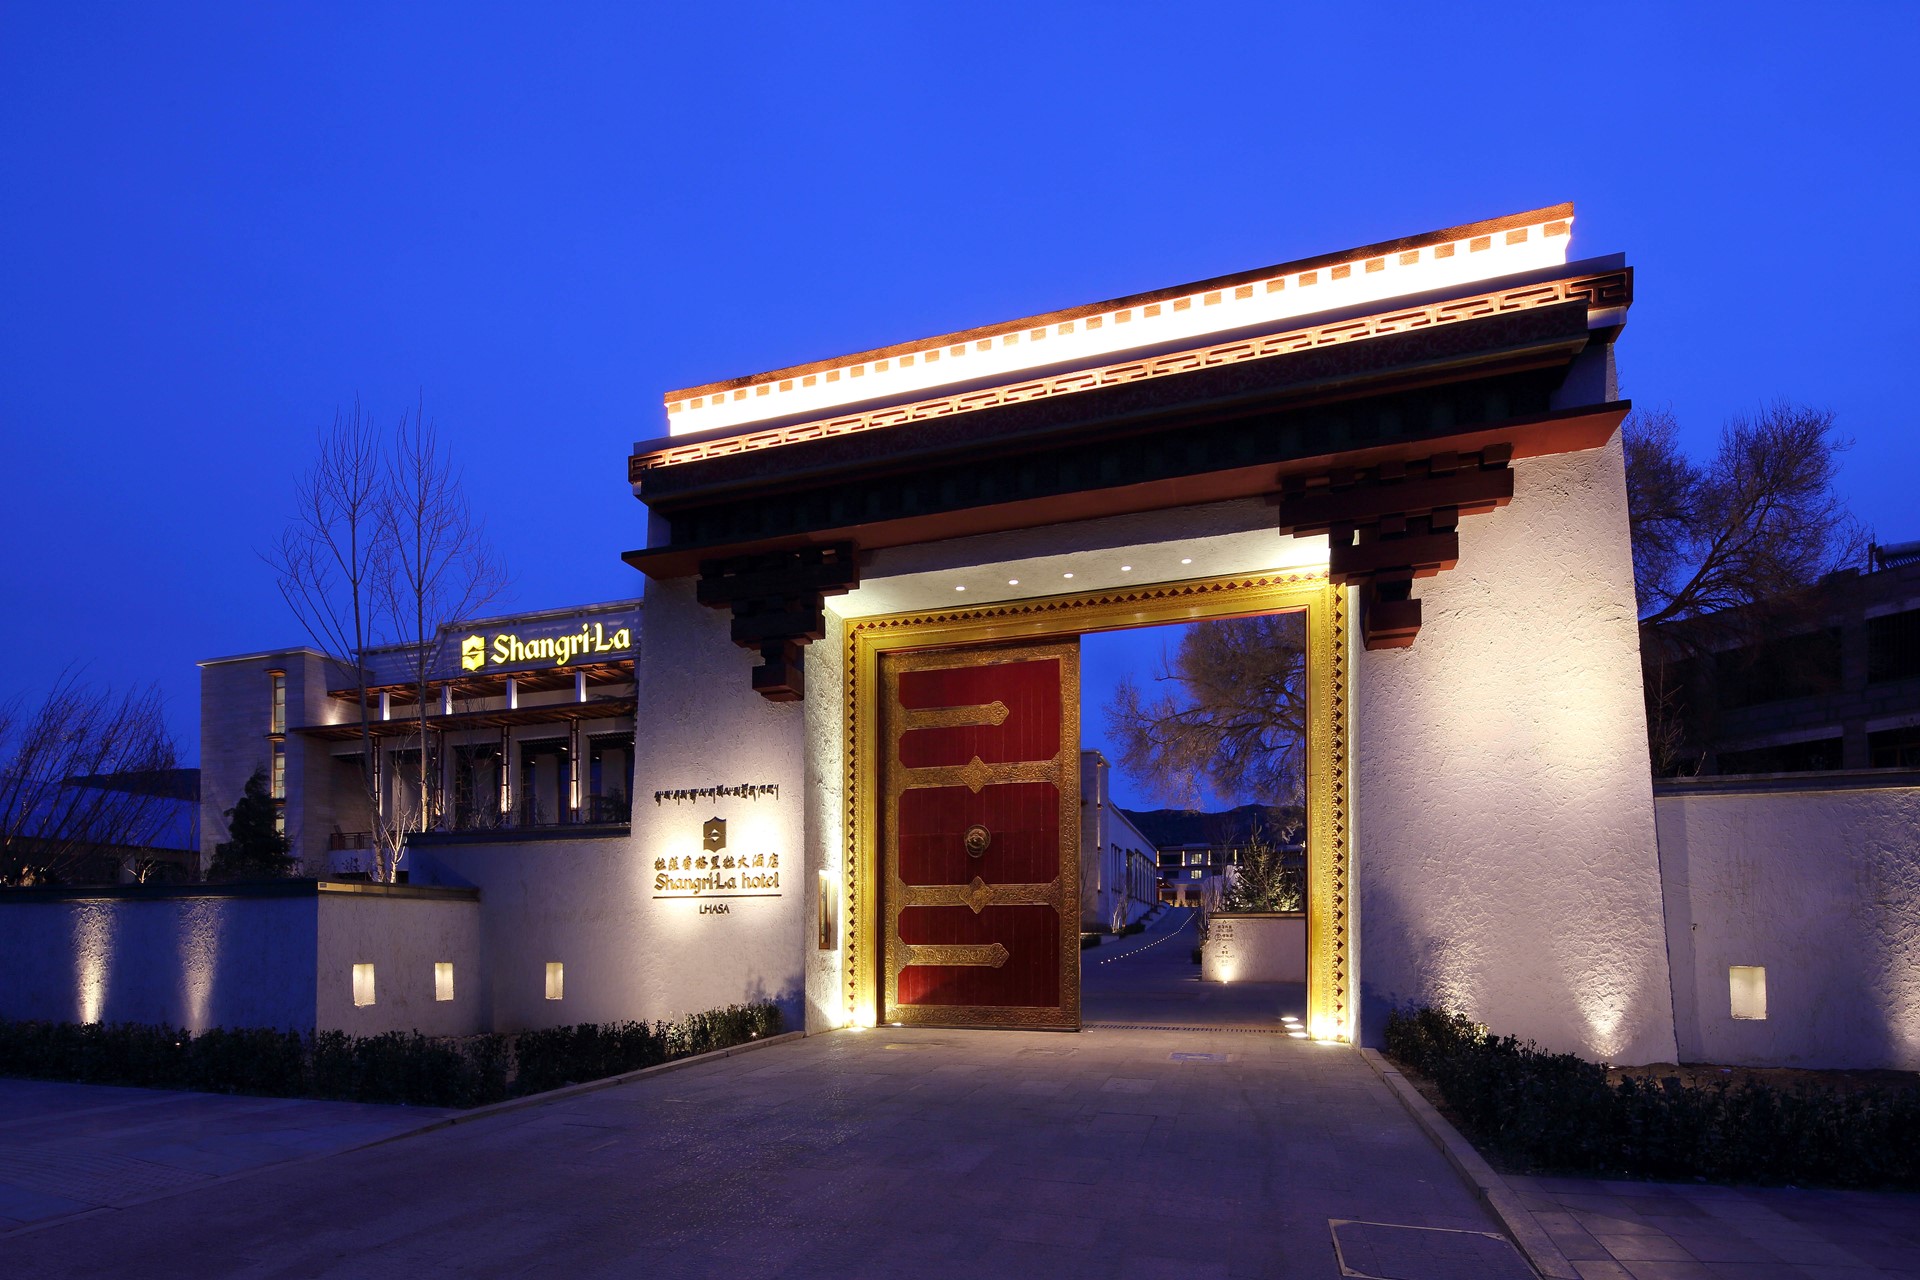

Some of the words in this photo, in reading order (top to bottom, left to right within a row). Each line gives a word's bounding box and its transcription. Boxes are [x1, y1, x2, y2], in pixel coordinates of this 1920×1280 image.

[490, 622, 631, 666] Shangri-La
[653, 872, 737, 895] Shangri-La
[741, 871, 780, 889] hotel
[699, 903, 730, 915] LHASA
